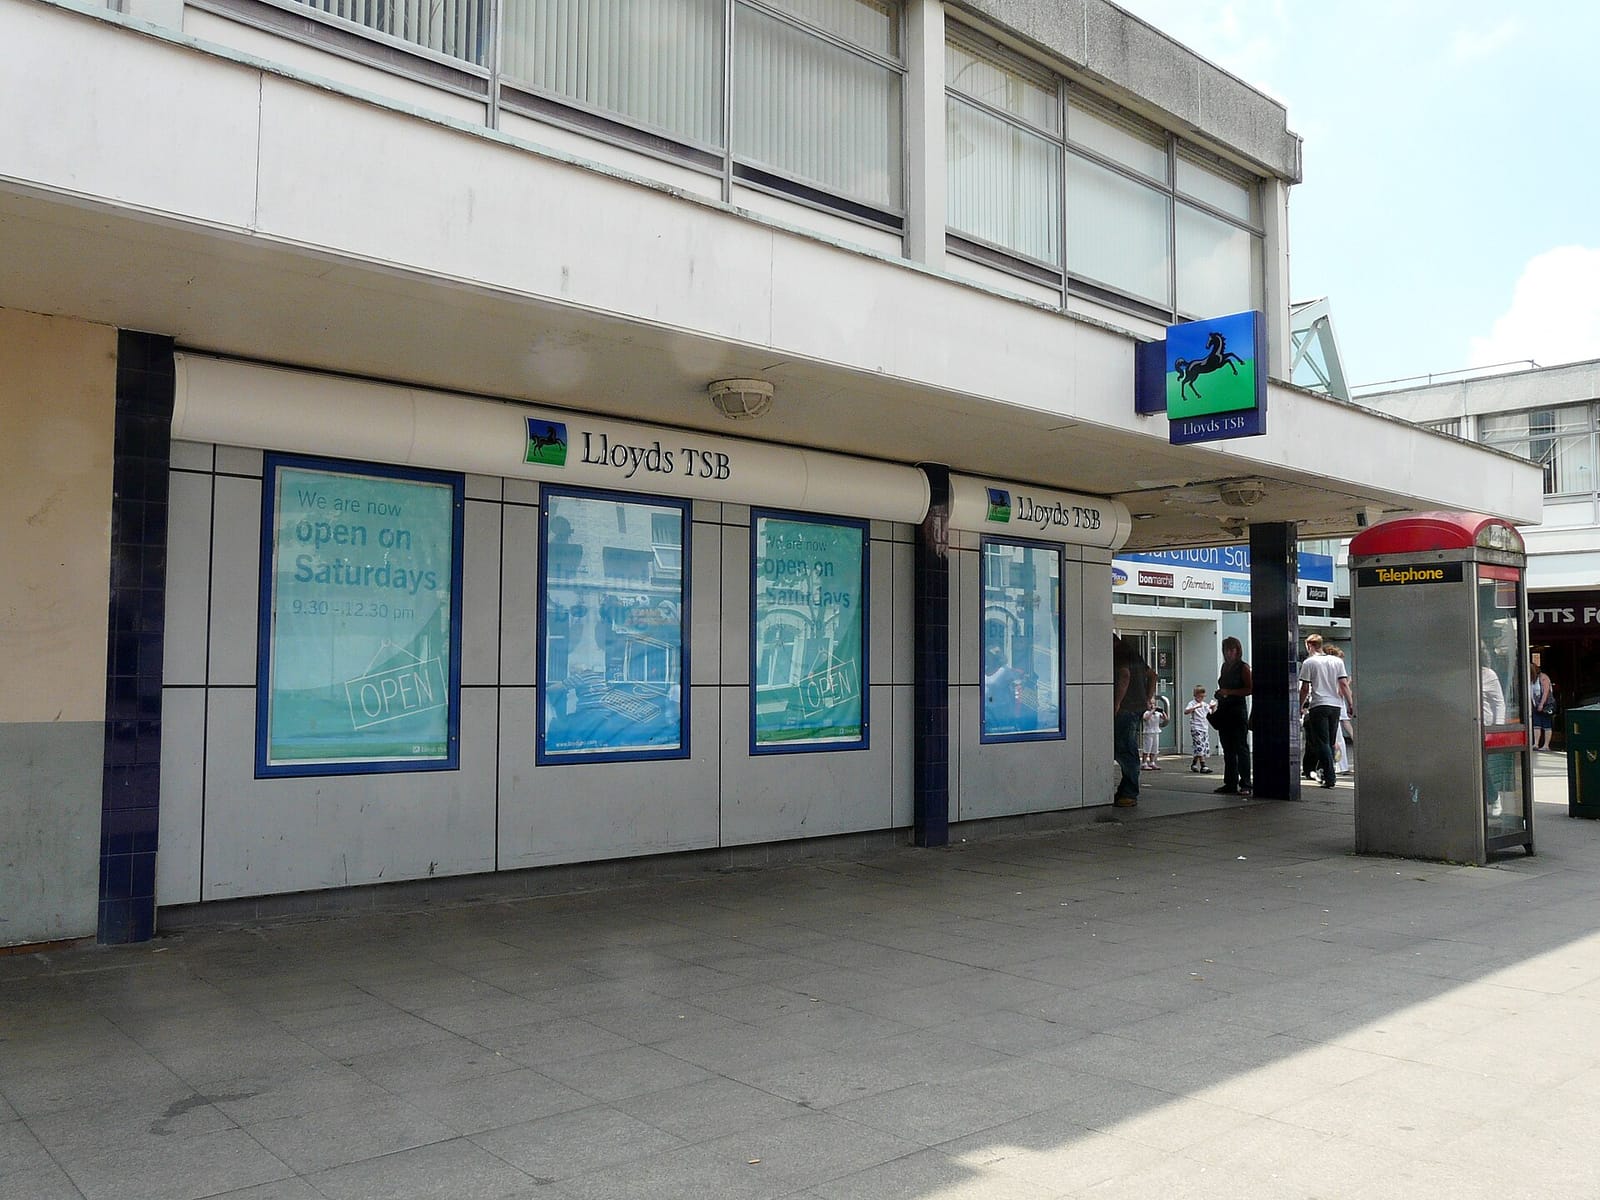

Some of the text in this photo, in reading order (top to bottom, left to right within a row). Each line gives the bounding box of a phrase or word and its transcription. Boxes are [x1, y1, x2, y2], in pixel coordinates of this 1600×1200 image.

[1183, 416, 1245, 436] Lloyds TSB
[581, 431, 731, 480] Lloyds TSB
[297, 489, 402, 517] We are now
[1017, 496, 1101, 531] Lloyds TSB
[296, 519, 411, 551] open on
[806, 540, 828, 551] now
[1137, 547, 1219, 564] arendon
[294, 553, 437, 597] Saturdays
[764, 558, 834, 580] open on
[1376, 567, 1444, 585] Telephone
[1181, 576, 1216, 591] Thorntons
[292, 599, 328, 616] 9.30
[345, 602, 389, 619] 12.30
[393, 606, 415, 622] pm
[360, 669, 434, 718] OPEN
[807, 667, 853, 708] OPEN
